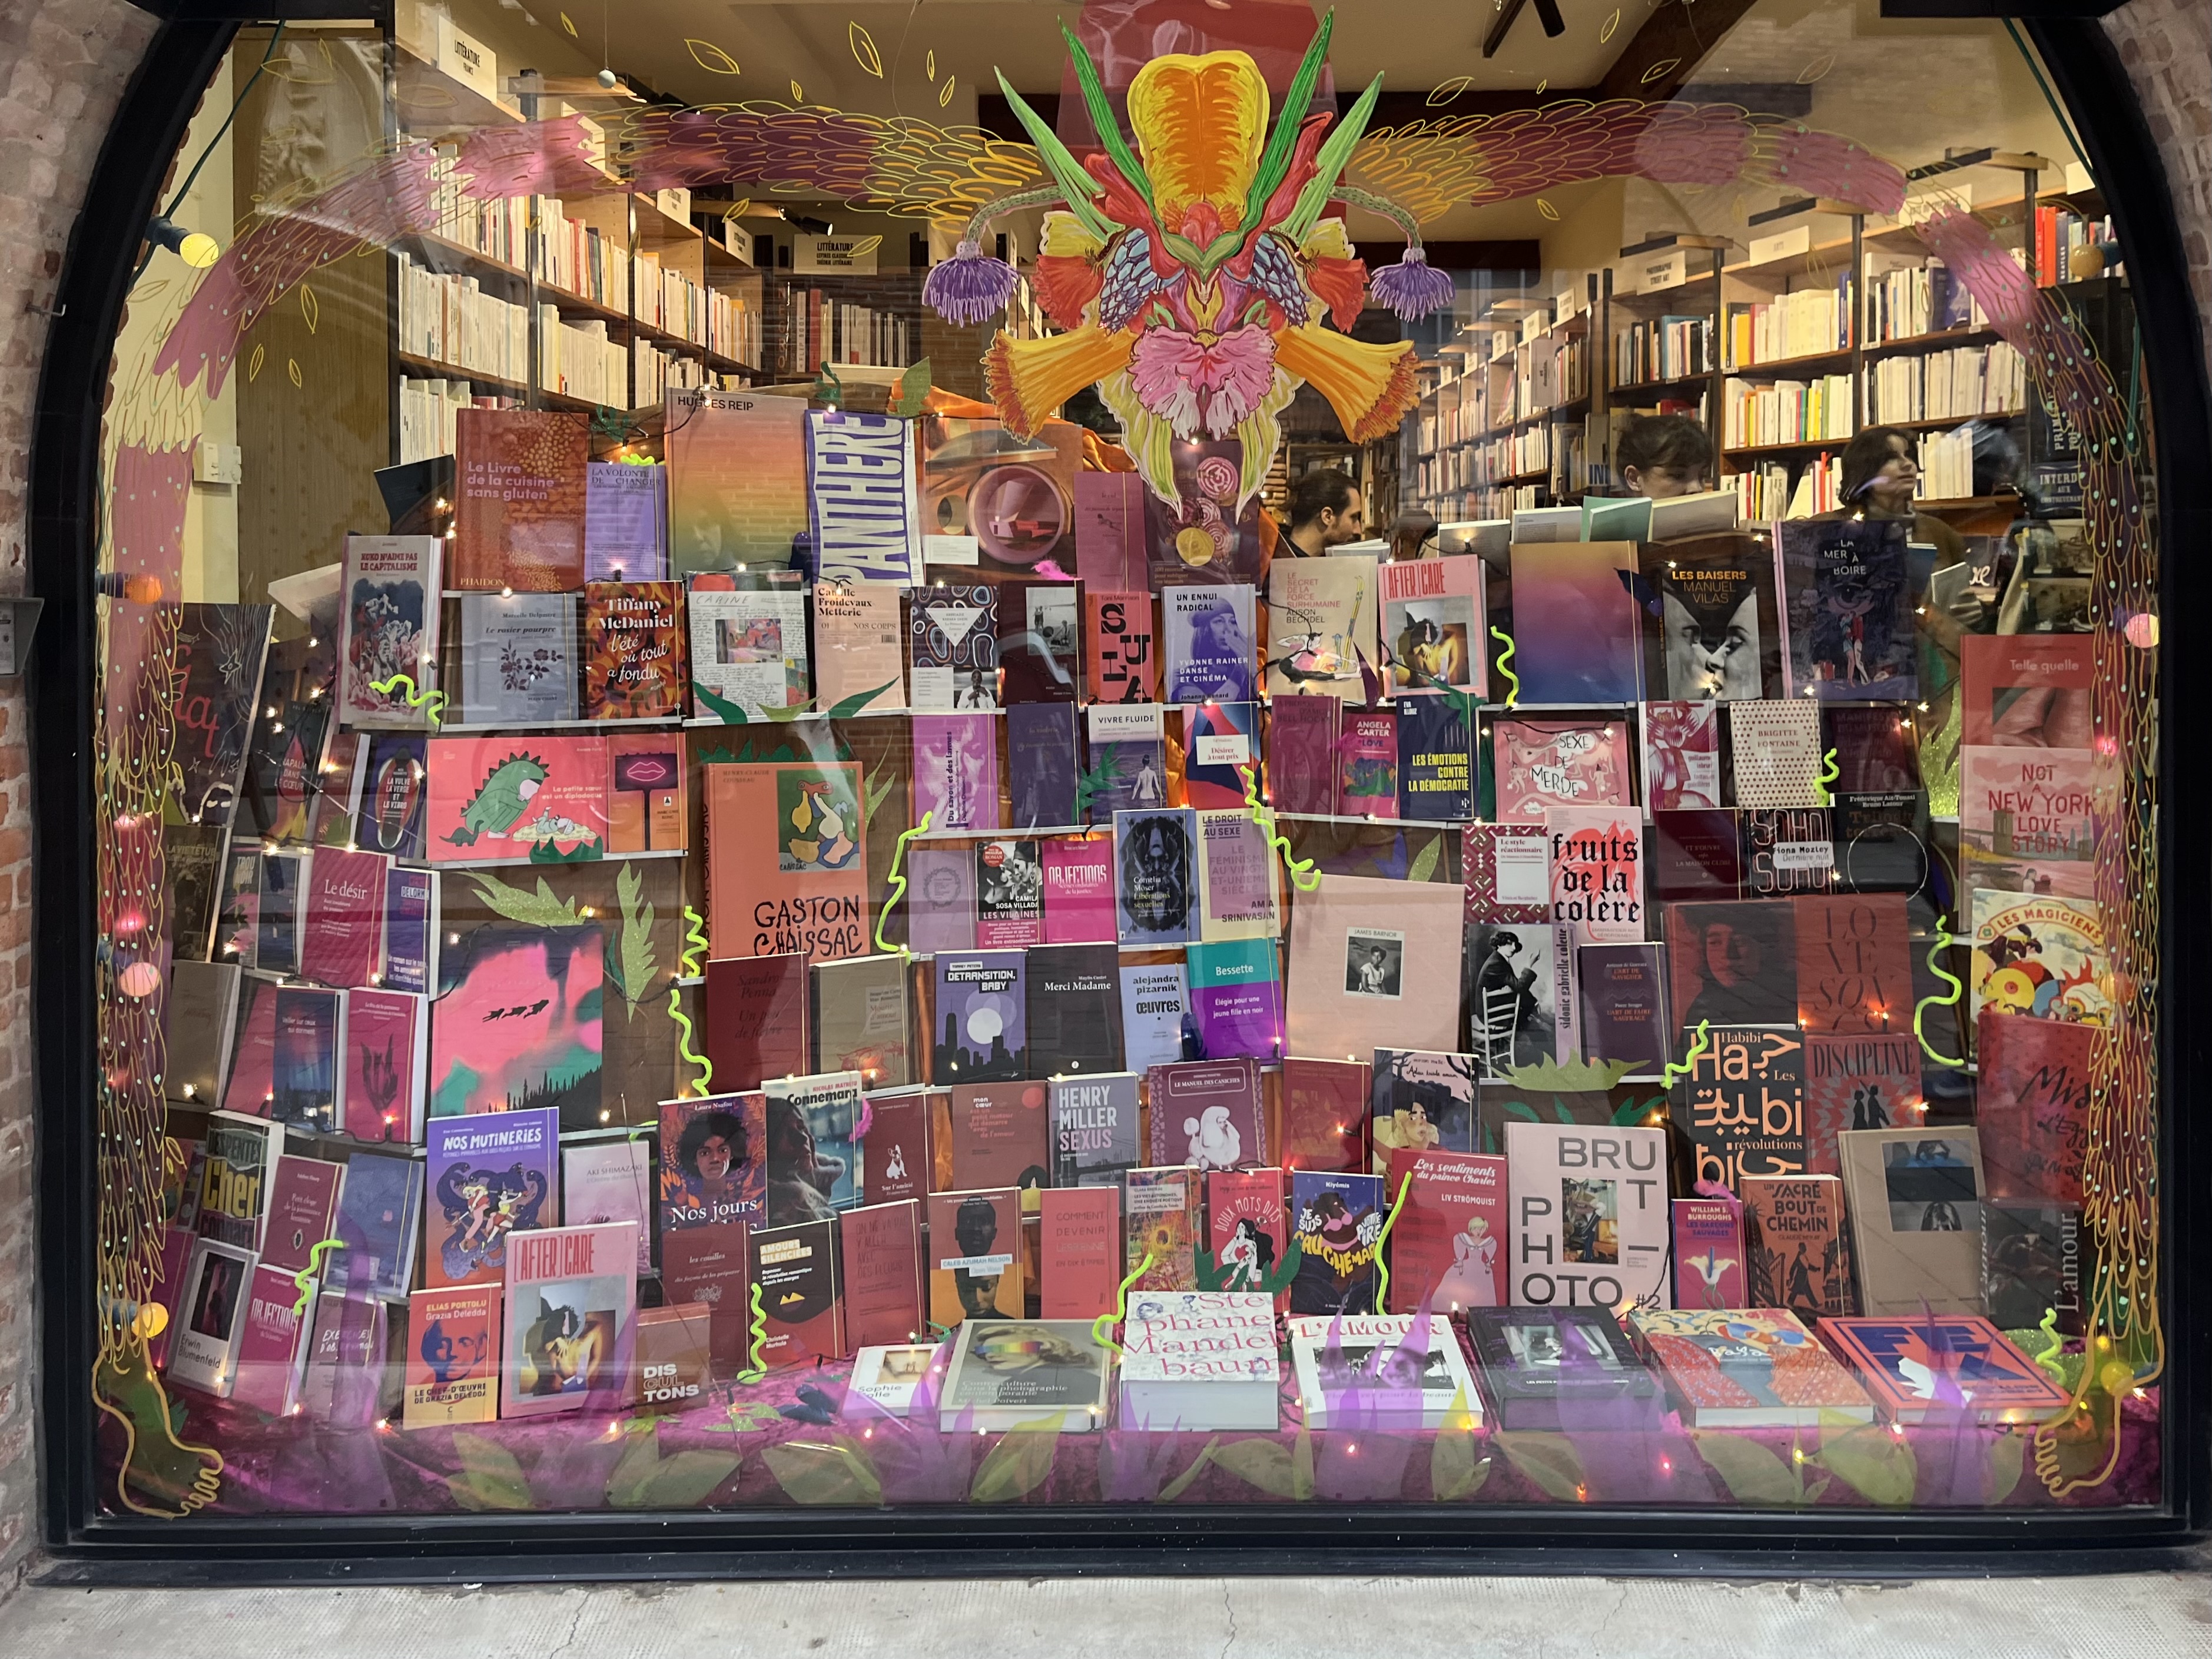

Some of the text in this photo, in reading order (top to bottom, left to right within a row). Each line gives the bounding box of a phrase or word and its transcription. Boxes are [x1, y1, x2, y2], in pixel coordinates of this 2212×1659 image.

[455, 39, 480, 68] LITTÉRATURE
[817, 241, 854, 251] LITTÉRATURE
[467, 462, 522, 473] Le Livre
[467, 475, 555, 487] de la cuisine
[616, 477, 661, 486] CHANGER
[467, 487, 548, 501] sans gluten
[1824, 550, 1859, 563] MER À
[1672, 570, 1747, 580] LES BAISERS
[460, 578, 505, 586] PHAIDON
[1683, 580, 1737, 593] MANUEL
[1191, 593, 1218, 601] ENNUI
[1692, 592, 1729, 604] VILAS
[605, 598, 662, 613] Tiffany
[599, 614, 673, 629] McDaniel
[612, 635, 639, 652] l'été
[1216, 657, 1248, 665] RAINER
[2009, 659, 2079, 673] Telle quelle
[607, 664, 660, 683] a fondu
[1193, 673, 1228, 682] CINÉMA
[1098, 715, 1155, 724] VIVRE FLUIDE
[1357, 721, 1391, 729] ANGELA
[1558, 735, 1590, 749] SEXE
[1225, 753, 1239, 762] prix
[1412, 752, 1468, 766] LES ÉMOTIONS
[1438, 766, 1468, 778] CONTRE
[2022, 764, 2058, 782] NOT
[1408, 778, 1469, 792] LA DÉMOCRATIE
[1531, 766, 1578, 797] MERDE
[2032, 784, 2041, 792] A
[1988, 790, 2097, 815] NEW YORK
[1202, 815, 1242, 824] LE DROIT
[2018, 816, 2062, 833] LOVE
[1203, 827, 1241, 836] AU SEXE
[1510, 838, 1526, 847] style
[1552, 833, 1639, 862] fruits
[2011, 835, 2070, 854] STORY
[1799, 846, 1829, 854] Mozley
[324, 879, 367, 900] Le désir
[1133, 900, 1163, 908] sexuelles
[1554, 894, 1640, 923] colère
[754, 895, 860, 928] GASTON
[1000, 911, 1039, 919] VILAINES
[1222, 912, 1275, 923] SRINIVASAN
[1997, 908, 2102, 940] LES MAGICIENS
[1373, 930, 1397, 938] BARNOR
[1215, 963, 1254, 976] Bessette
[981, 980, 1007, 991] BABY
[1044, 980, 1112, 991] Merci Madame
[1133, 975, 1180, 986] alejandra
[1136, 984, 1178, 995] pizarnik
[1136, 998, 1180, 1015] œuvres
[1215, 997, 1232, 1006] Élégie
[1213, 1010, 1229, 1018] jeune
[1721, 1032, 1761, 1044] Habibi
[1812, 1040, 1916, 1079] DISCIPLINE
[1213, 1077, 1241, 1085] CANICHES
[1773, 1070, 1796, 1081] Les
[787, 1088, 857, 1107] Connemara
[1059, 1085, 1111, 1107] HENRY
[1059, 1107, 1117, 1130] MILLER
[1059, 1129, 1113, 1152] SEXUS
[1735, 1138, 1803, 1151] révolutions
[1414, 1159, 1496, 1178] Les sentiments
[1325, 1181, 1349, 1189] Kiyémis
[1772, 1180, 1821, 1199] SACRÉ
[1441, 1193, 1496, 1206] LIV STRÖMQUIST
[671, 1199, 758, 1224] Nos jours
[1056, 1210, 1105, 1221] COMMENT
[1056, 1226, 1106, 1236] DEVENIR
[1767, 1217, 1828, 1232] CHEMIN
[943, 1255, 1010, 1268] CALEB AZUMAH NELSON
[426, 1299, 487, 1312] ELIAS PORTOLU
[425, 1308, 486, 1320] Grazia Deledda
[180, 1333, 201, 1350] Erwin
[178, 1345, 222, 1369] Blumenfeld
[643, 1385, 699, 1402] TONS
[858, 1384, 902, 1393] Sophie
[454, 1391, 487, 1400] DELEDDA
